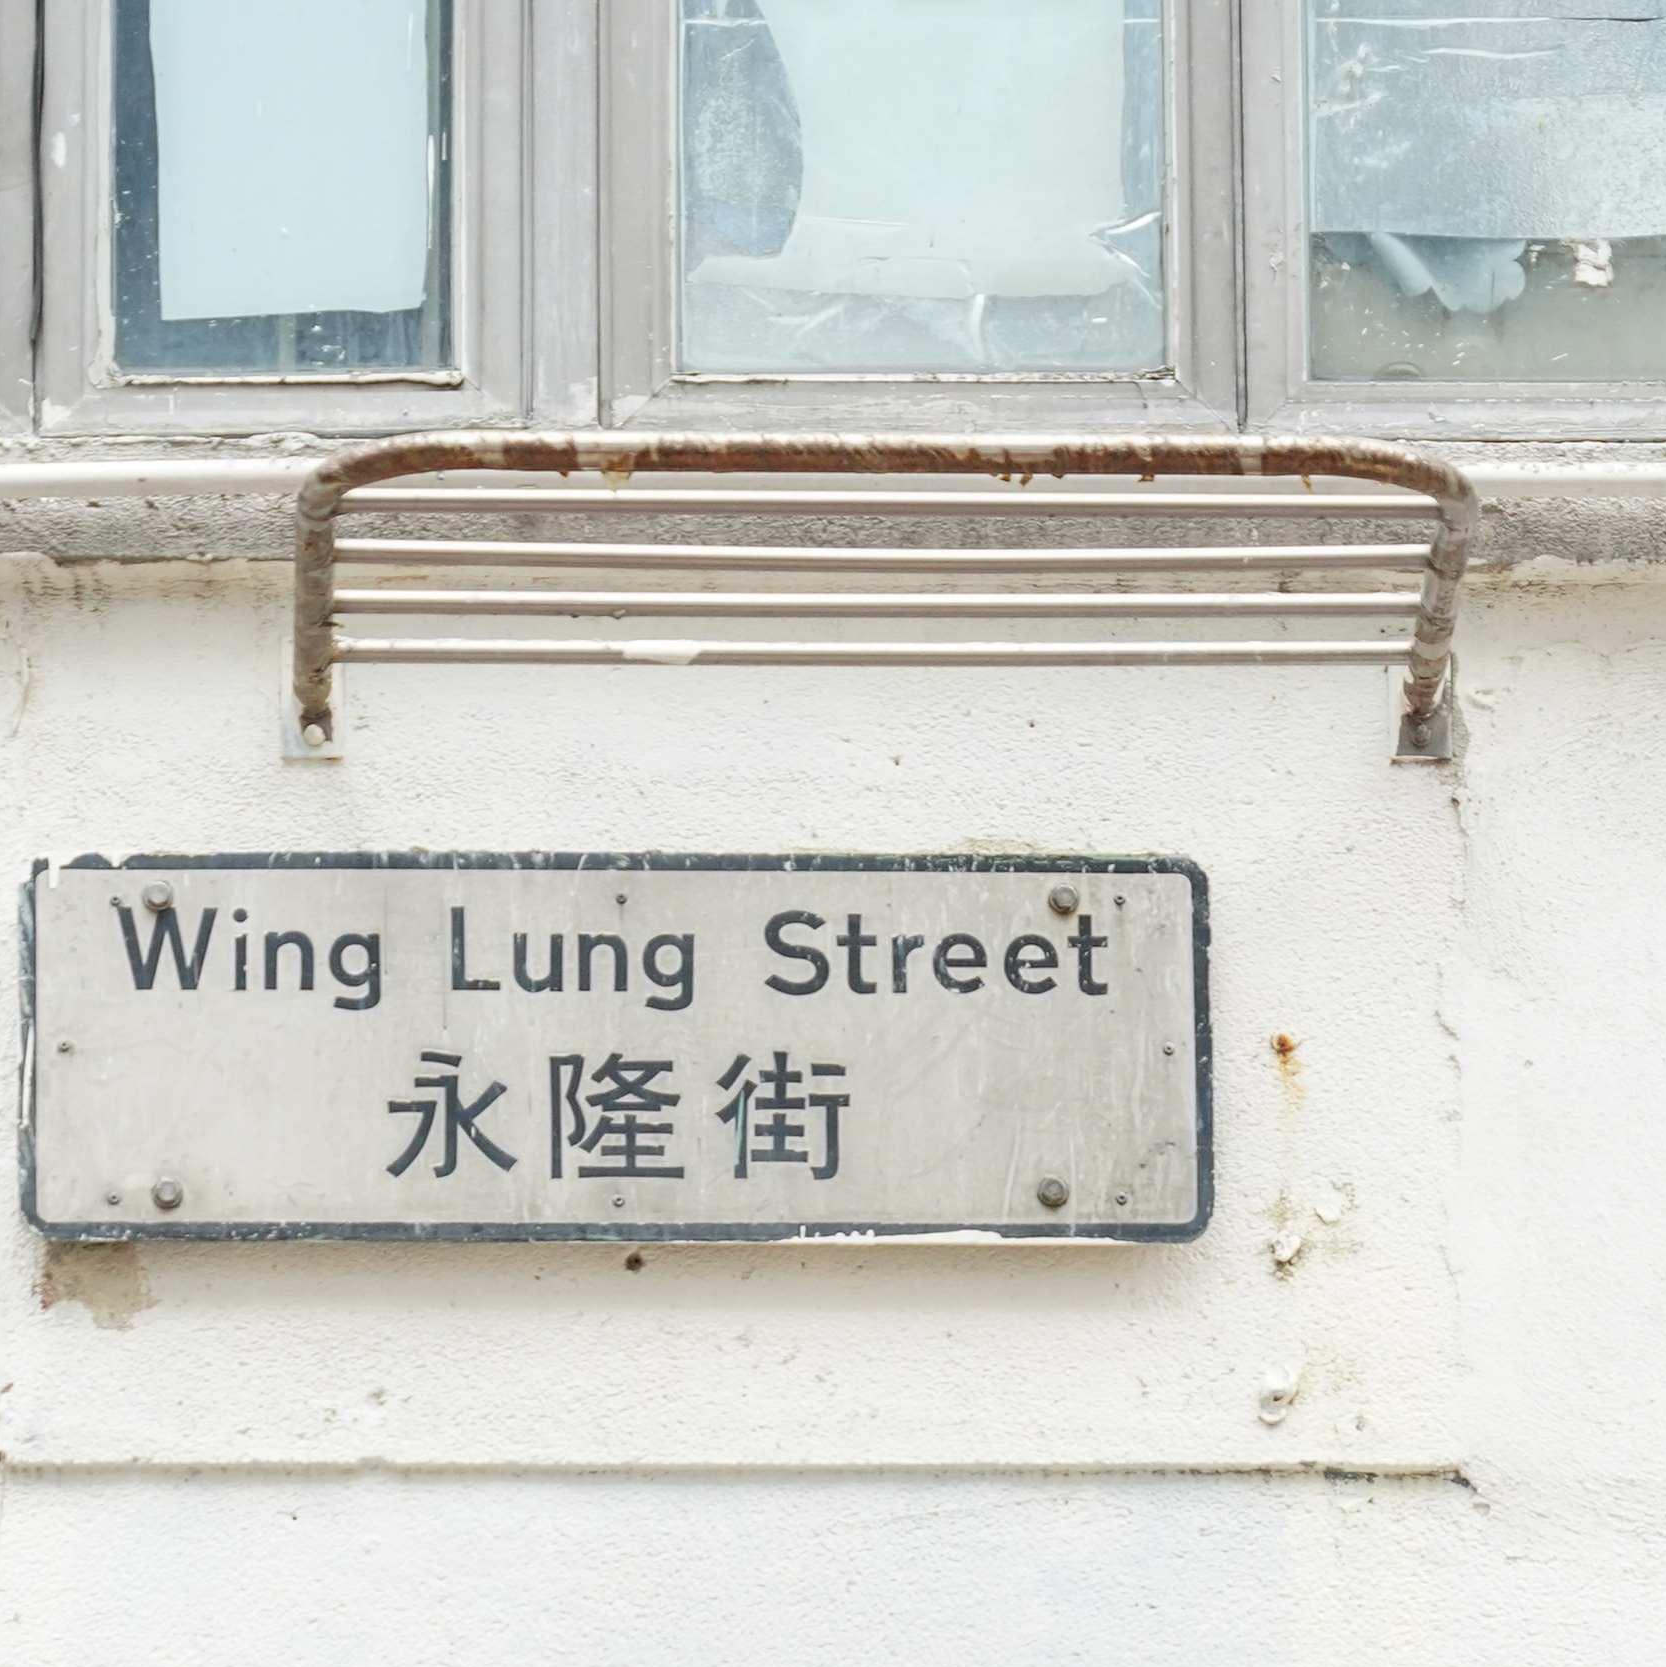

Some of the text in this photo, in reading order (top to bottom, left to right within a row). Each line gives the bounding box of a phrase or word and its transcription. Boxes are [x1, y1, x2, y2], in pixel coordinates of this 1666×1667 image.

[117, 904, 1110, 1012] Wing Lung Street
[385, 1050, 852, 1181] 永隆街
